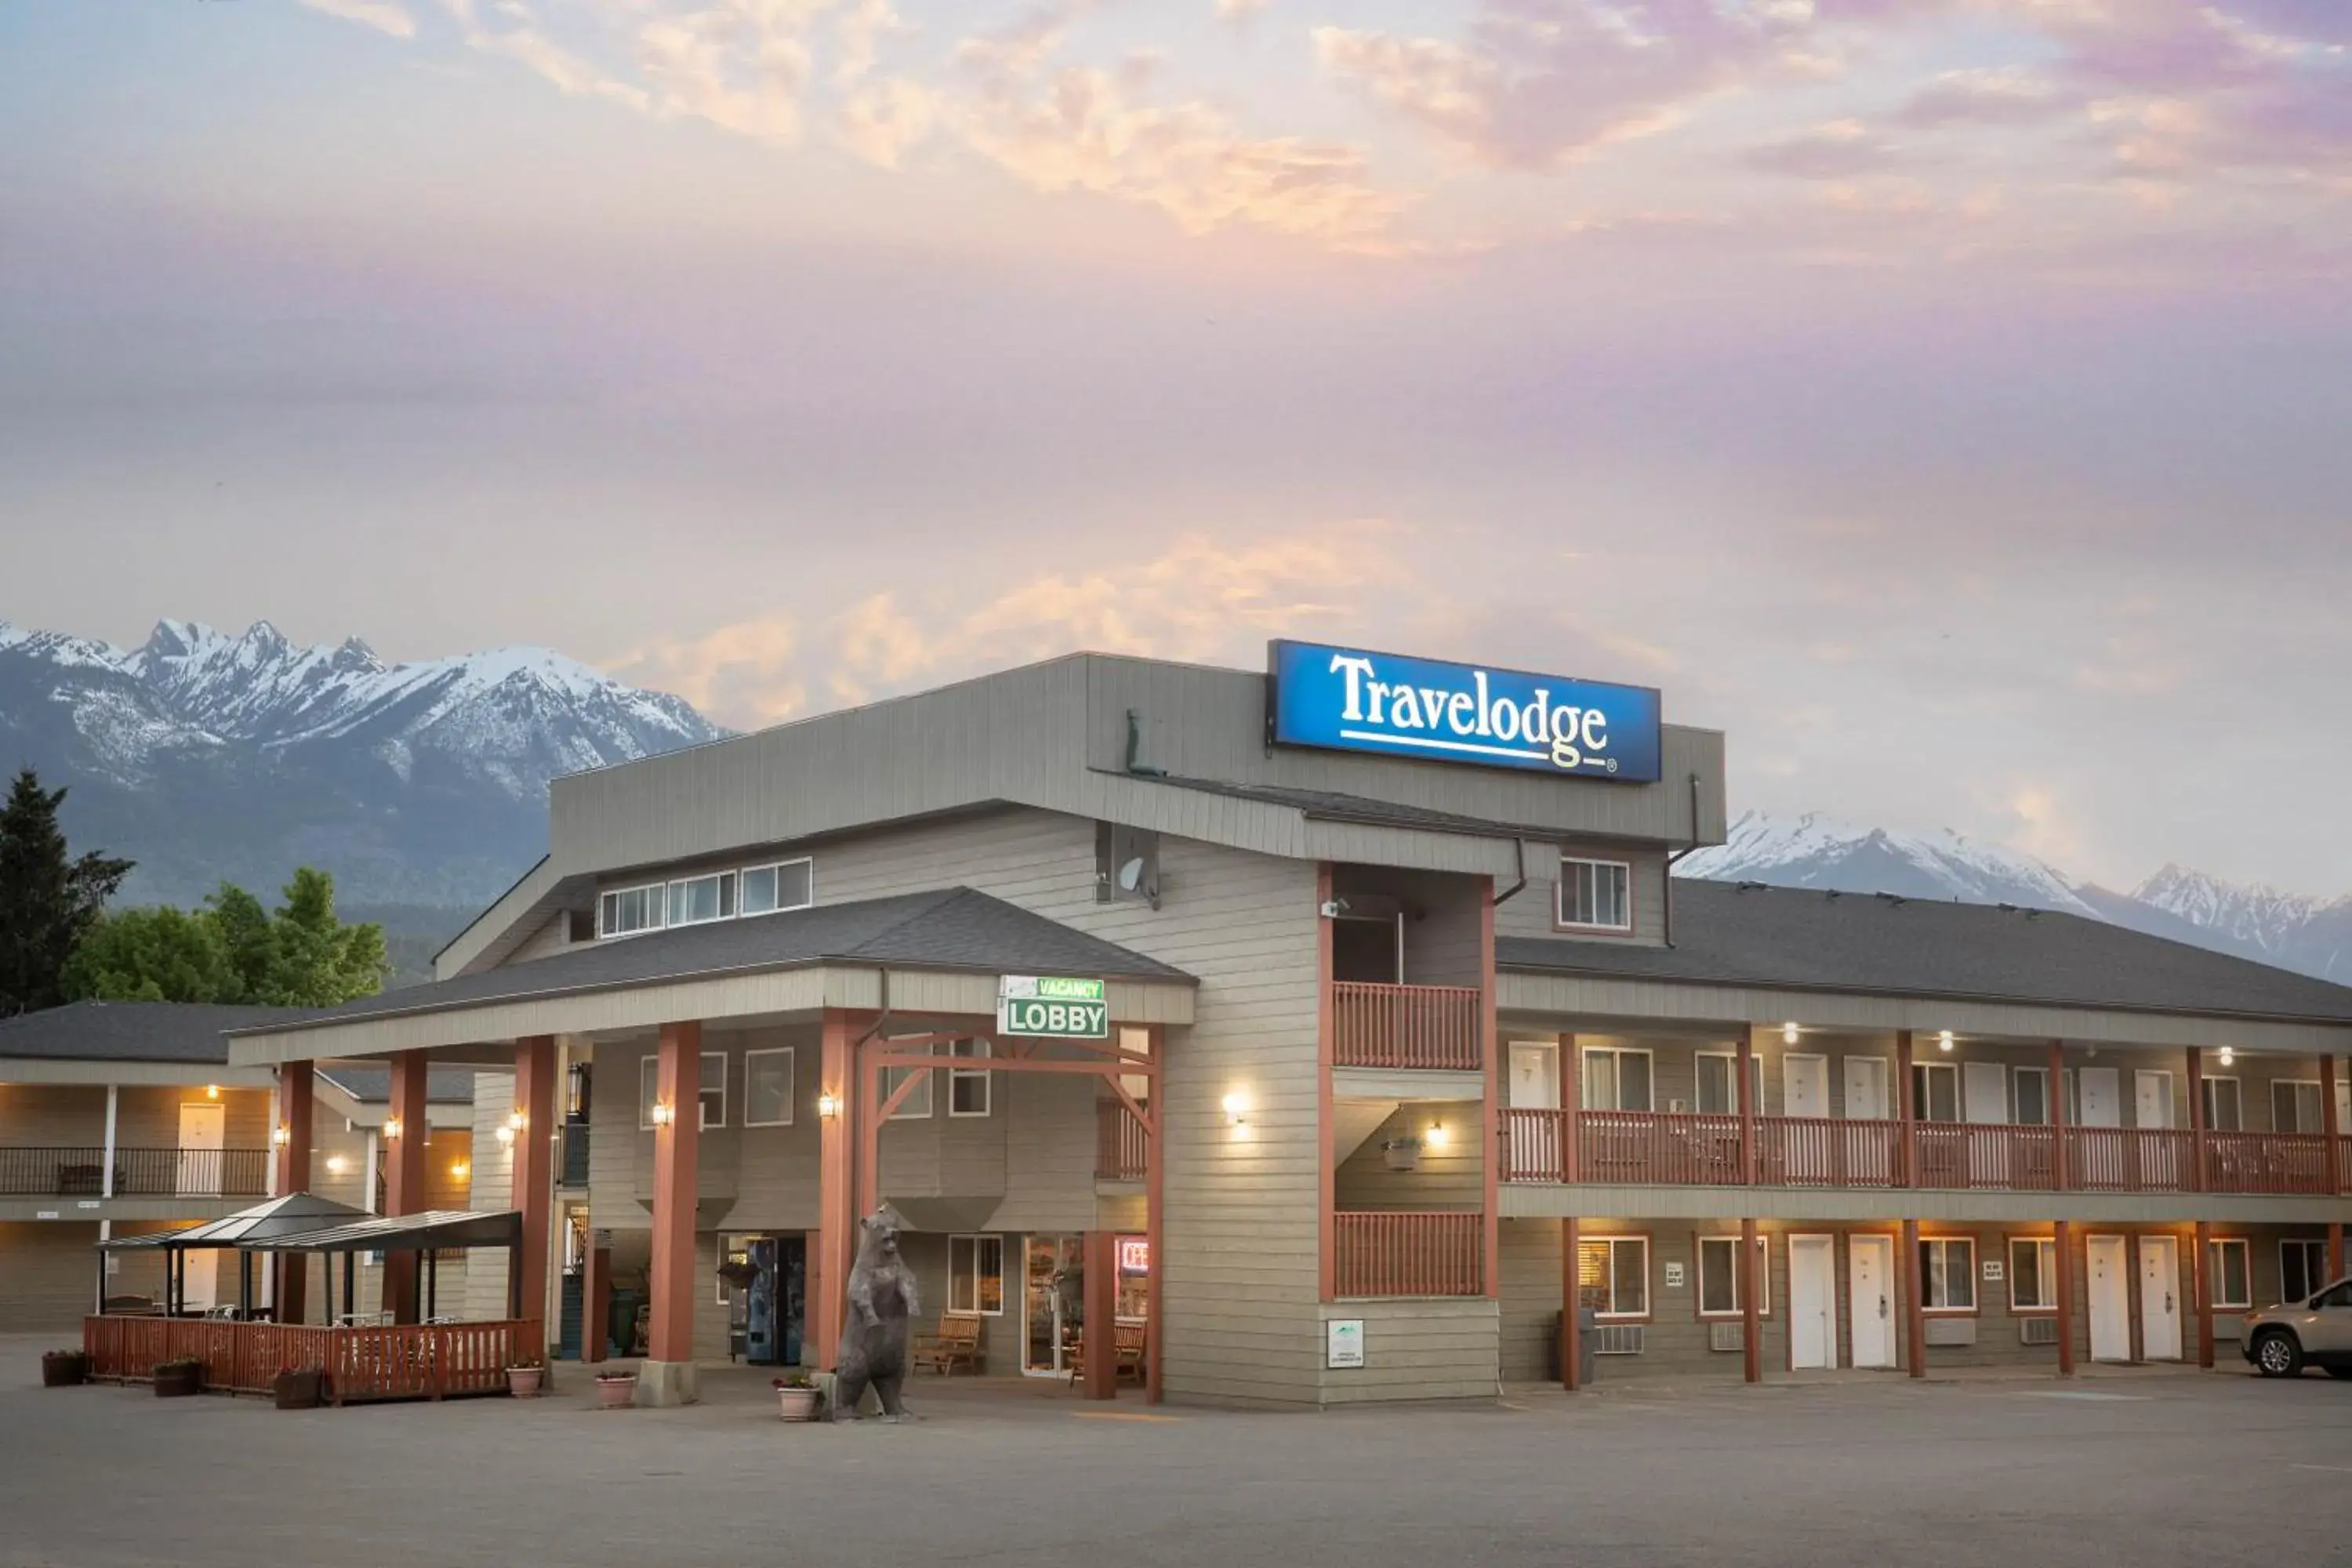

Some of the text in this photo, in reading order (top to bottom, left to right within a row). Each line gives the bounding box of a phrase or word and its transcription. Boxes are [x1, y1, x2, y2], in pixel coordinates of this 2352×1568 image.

[1330, 655, 1607, 768] Travelodge
[1040, 980, 1099, 997] VACANCY
[1010, 1003, 1104, 1032] LOBBY
[1123, 1244, 1148, 1266] OPE
